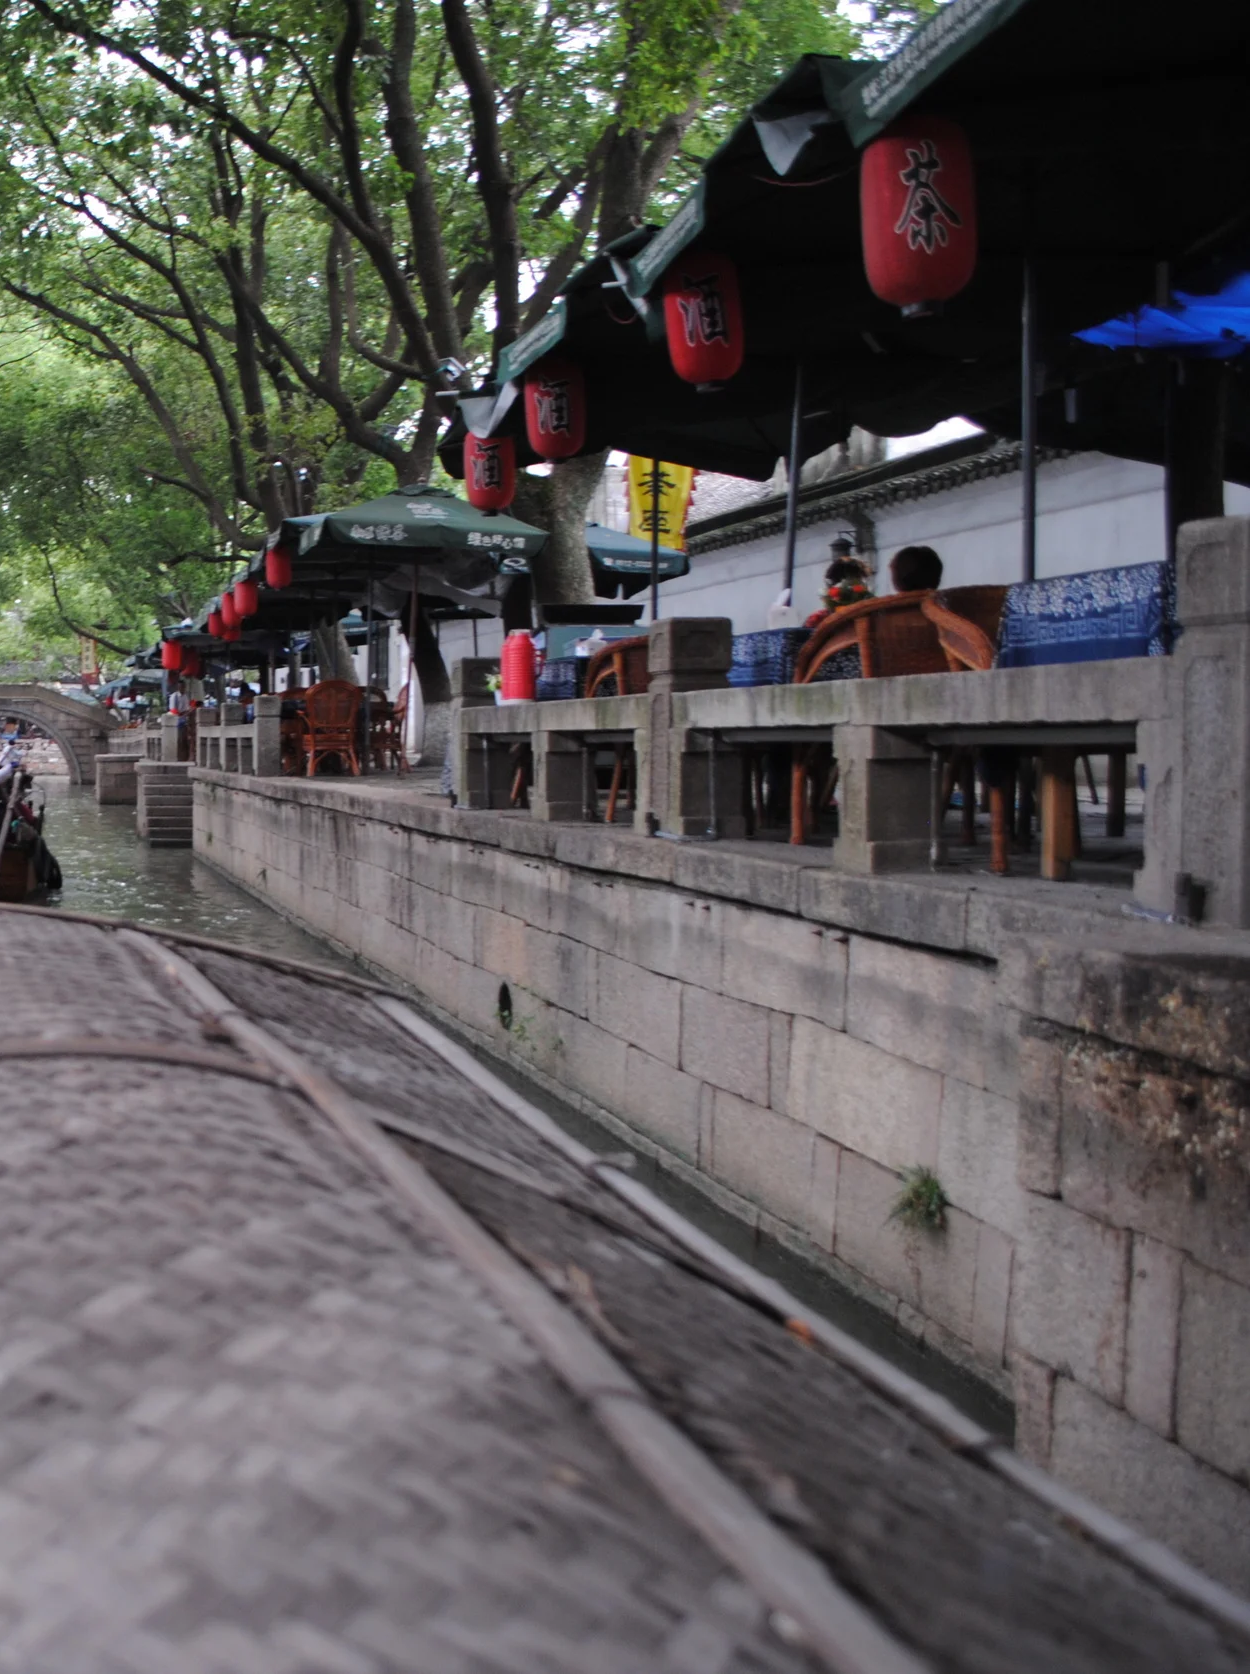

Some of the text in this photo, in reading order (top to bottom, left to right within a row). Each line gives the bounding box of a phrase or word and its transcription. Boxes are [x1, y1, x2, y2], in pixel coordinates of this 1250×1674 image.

[894, 139, 962, 255] 茶
[677, 272, 731, 348] 酒
[534, 374, 571, 438] 酒
[470, 440, 502, 491] 酒
[637, 471, 676, 534] 茶座
